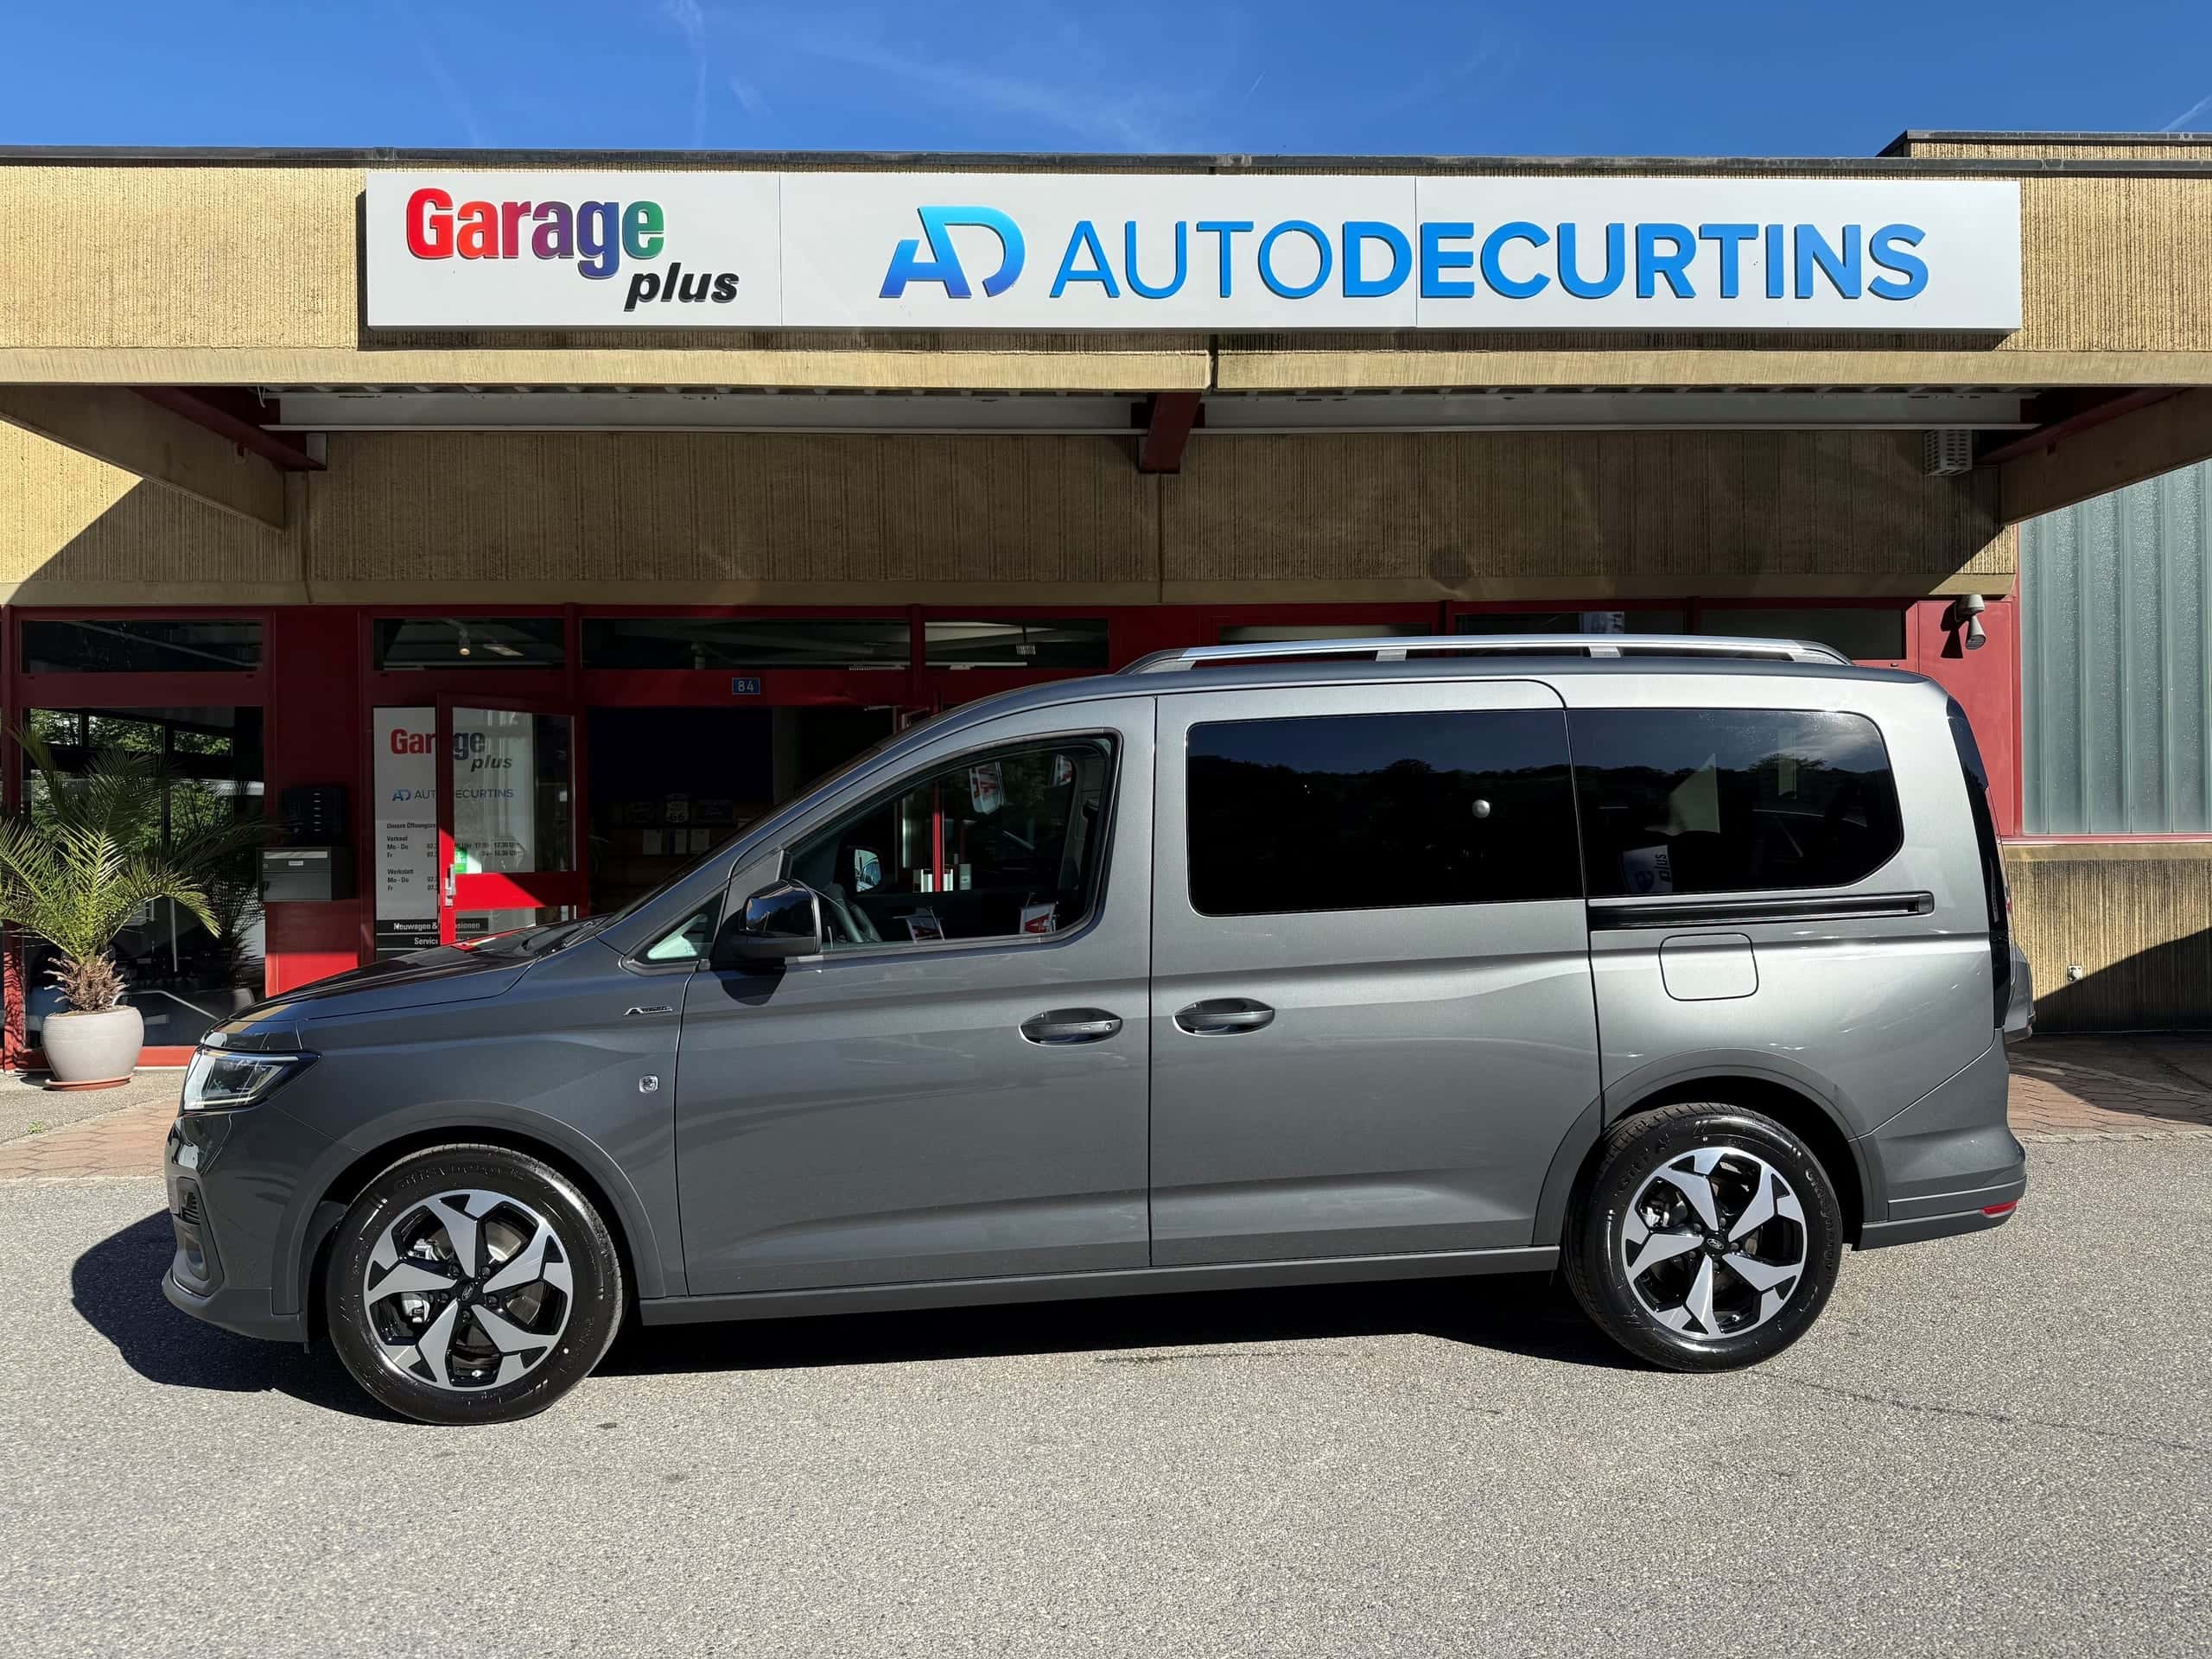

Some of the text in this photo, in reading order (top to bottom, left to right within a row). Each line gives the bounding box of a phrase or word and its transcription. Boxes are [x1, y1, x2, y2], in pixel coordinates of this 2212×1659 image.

[405, 188, 664, 278] Garage
[1049, 219, 1929, 301] AUTODECURTINS
[624, 262, 741, 312] plus
[738, 680, 754, 692] 84
[391, 728, 486, 760] Garge
[470, 754, 513, 772] plus
[414, 788, 514, 800] AUTECURTINS
[393, 922, 431, 931] Neuwagen
[414, 937, 438, 945] Servic
